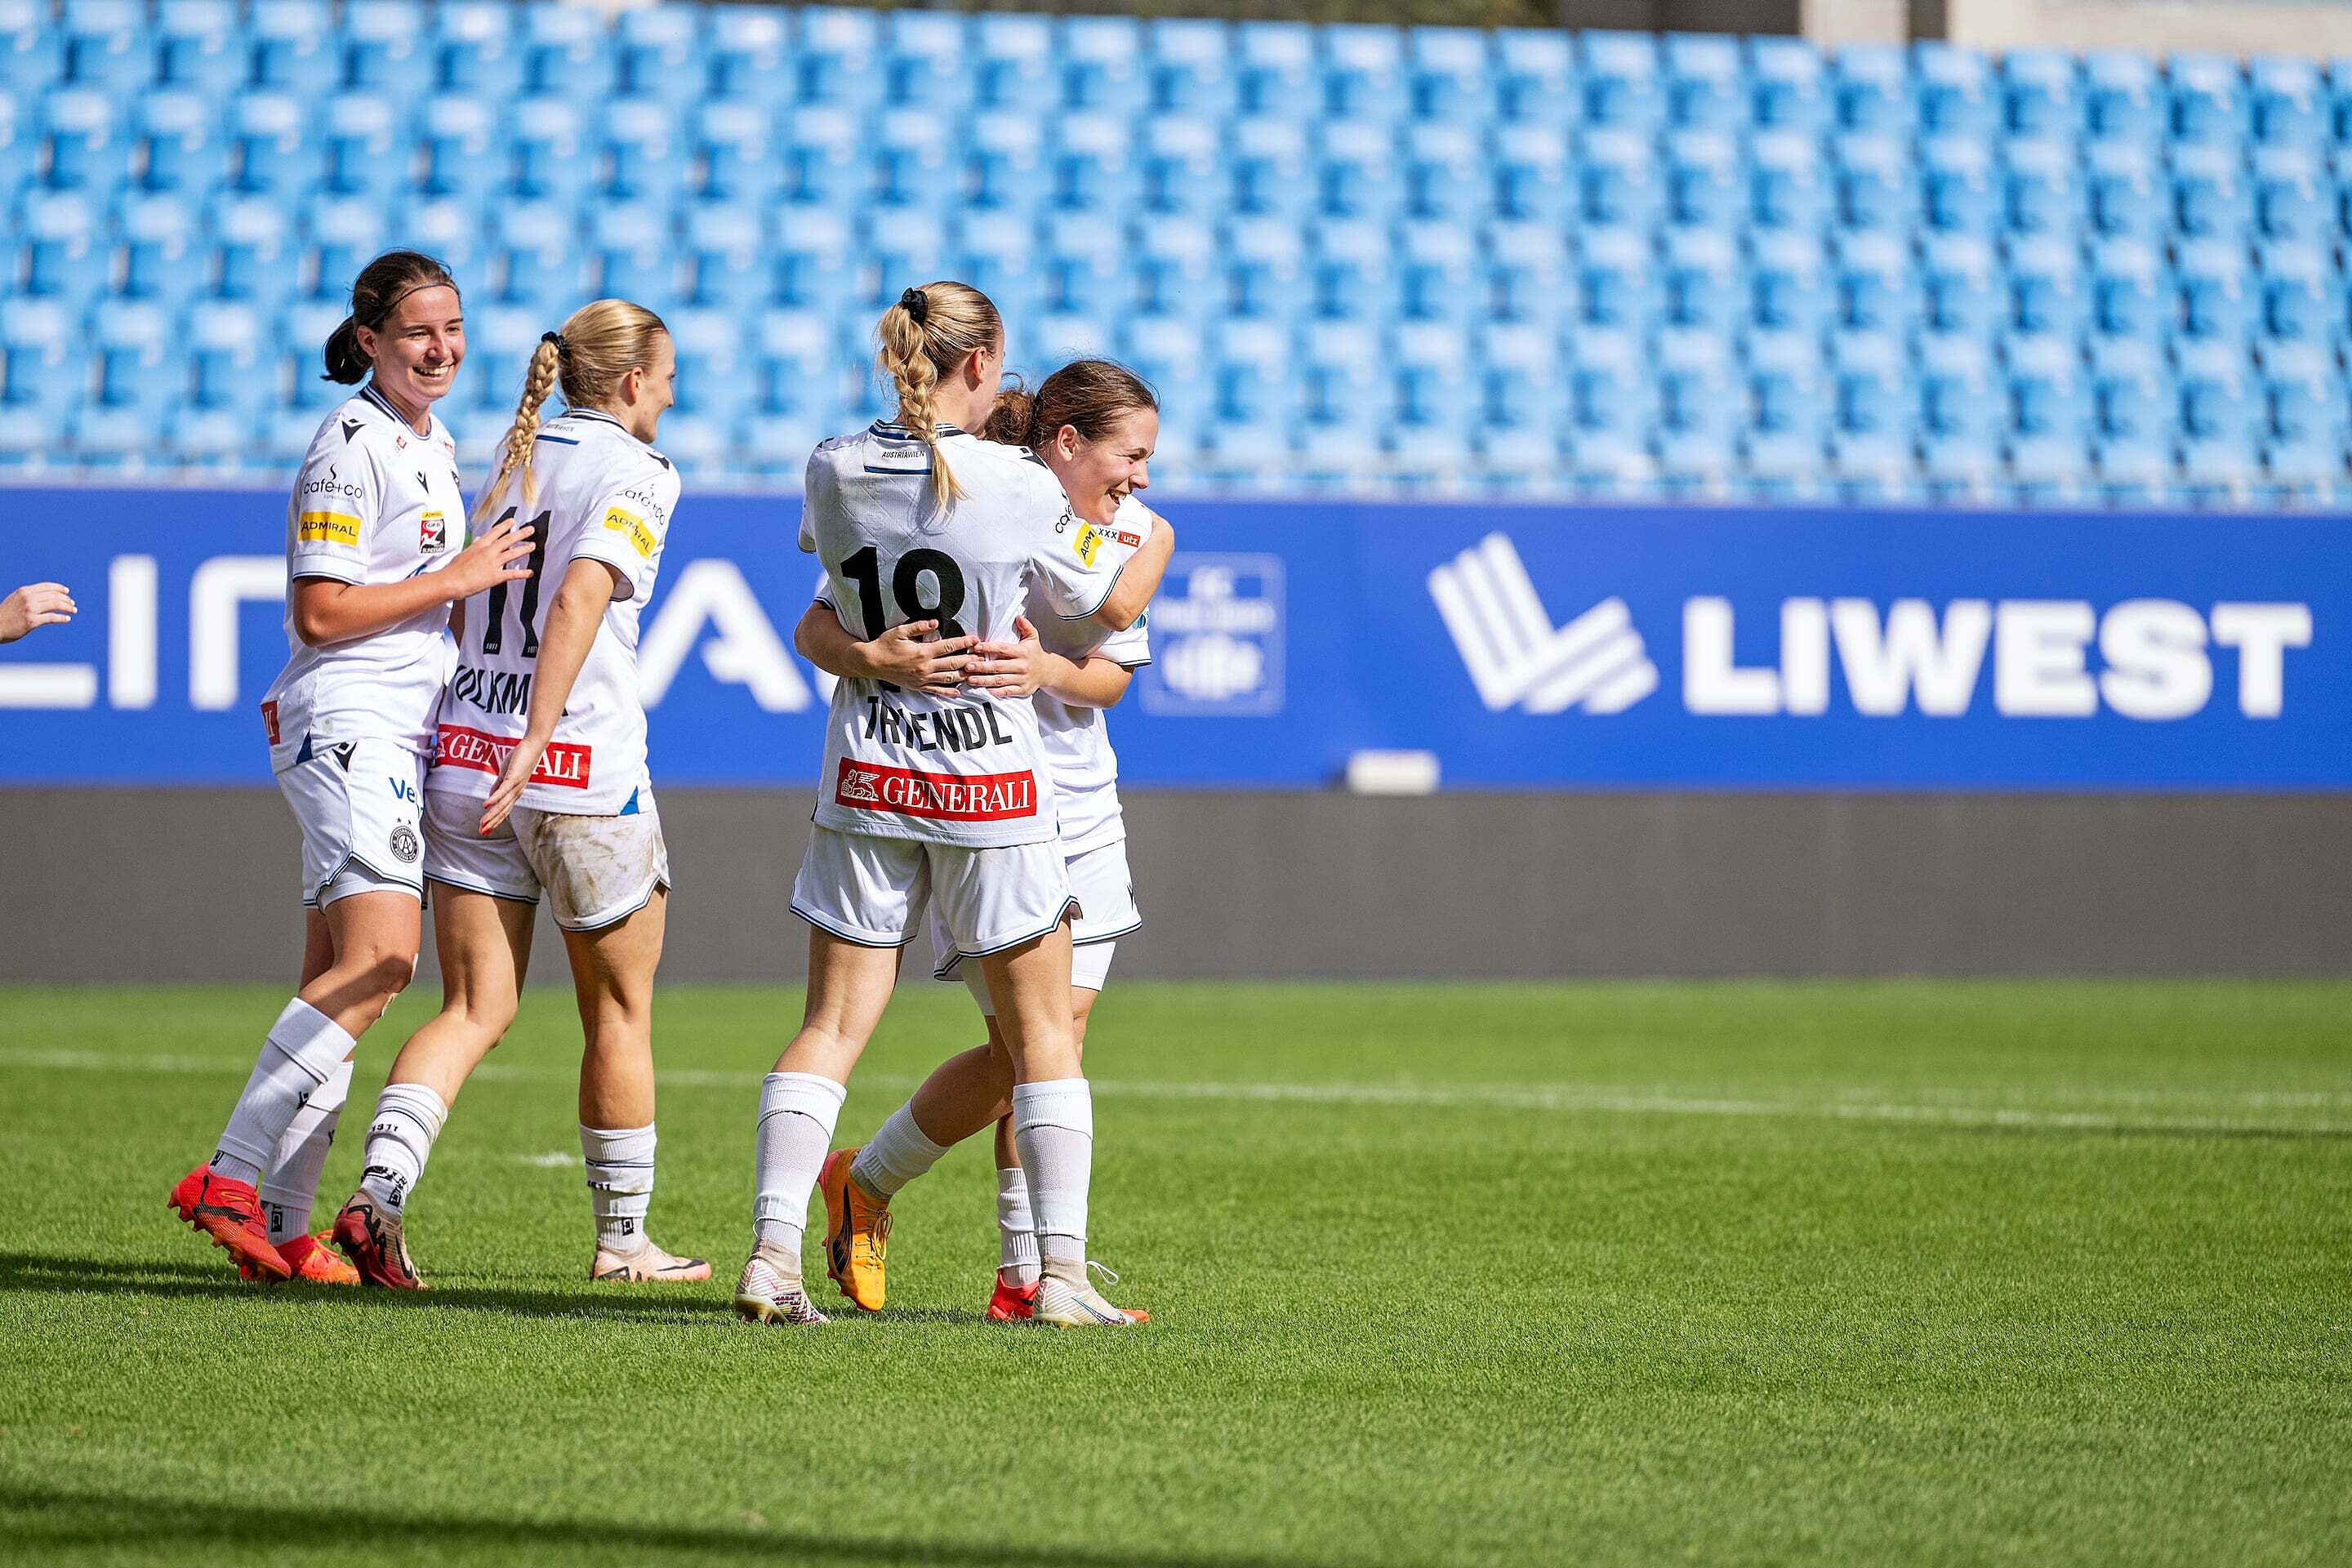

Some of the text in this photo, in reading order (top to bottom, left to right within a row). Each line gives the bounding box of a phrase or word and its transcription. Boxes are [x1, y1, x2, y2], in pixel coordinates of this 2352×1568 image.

[301, 521, 357, 537] ADMIRAL
[483, 506, 552, 658] 11
[840, 546, 969, 693] 18
[1682, 595, 2314, 720] LIWEST
[864, 695, 1013, 753] TRIENDL
[449, 733, 583, 781] GENALI
[883, 775, 1031, 814] GENERALI
